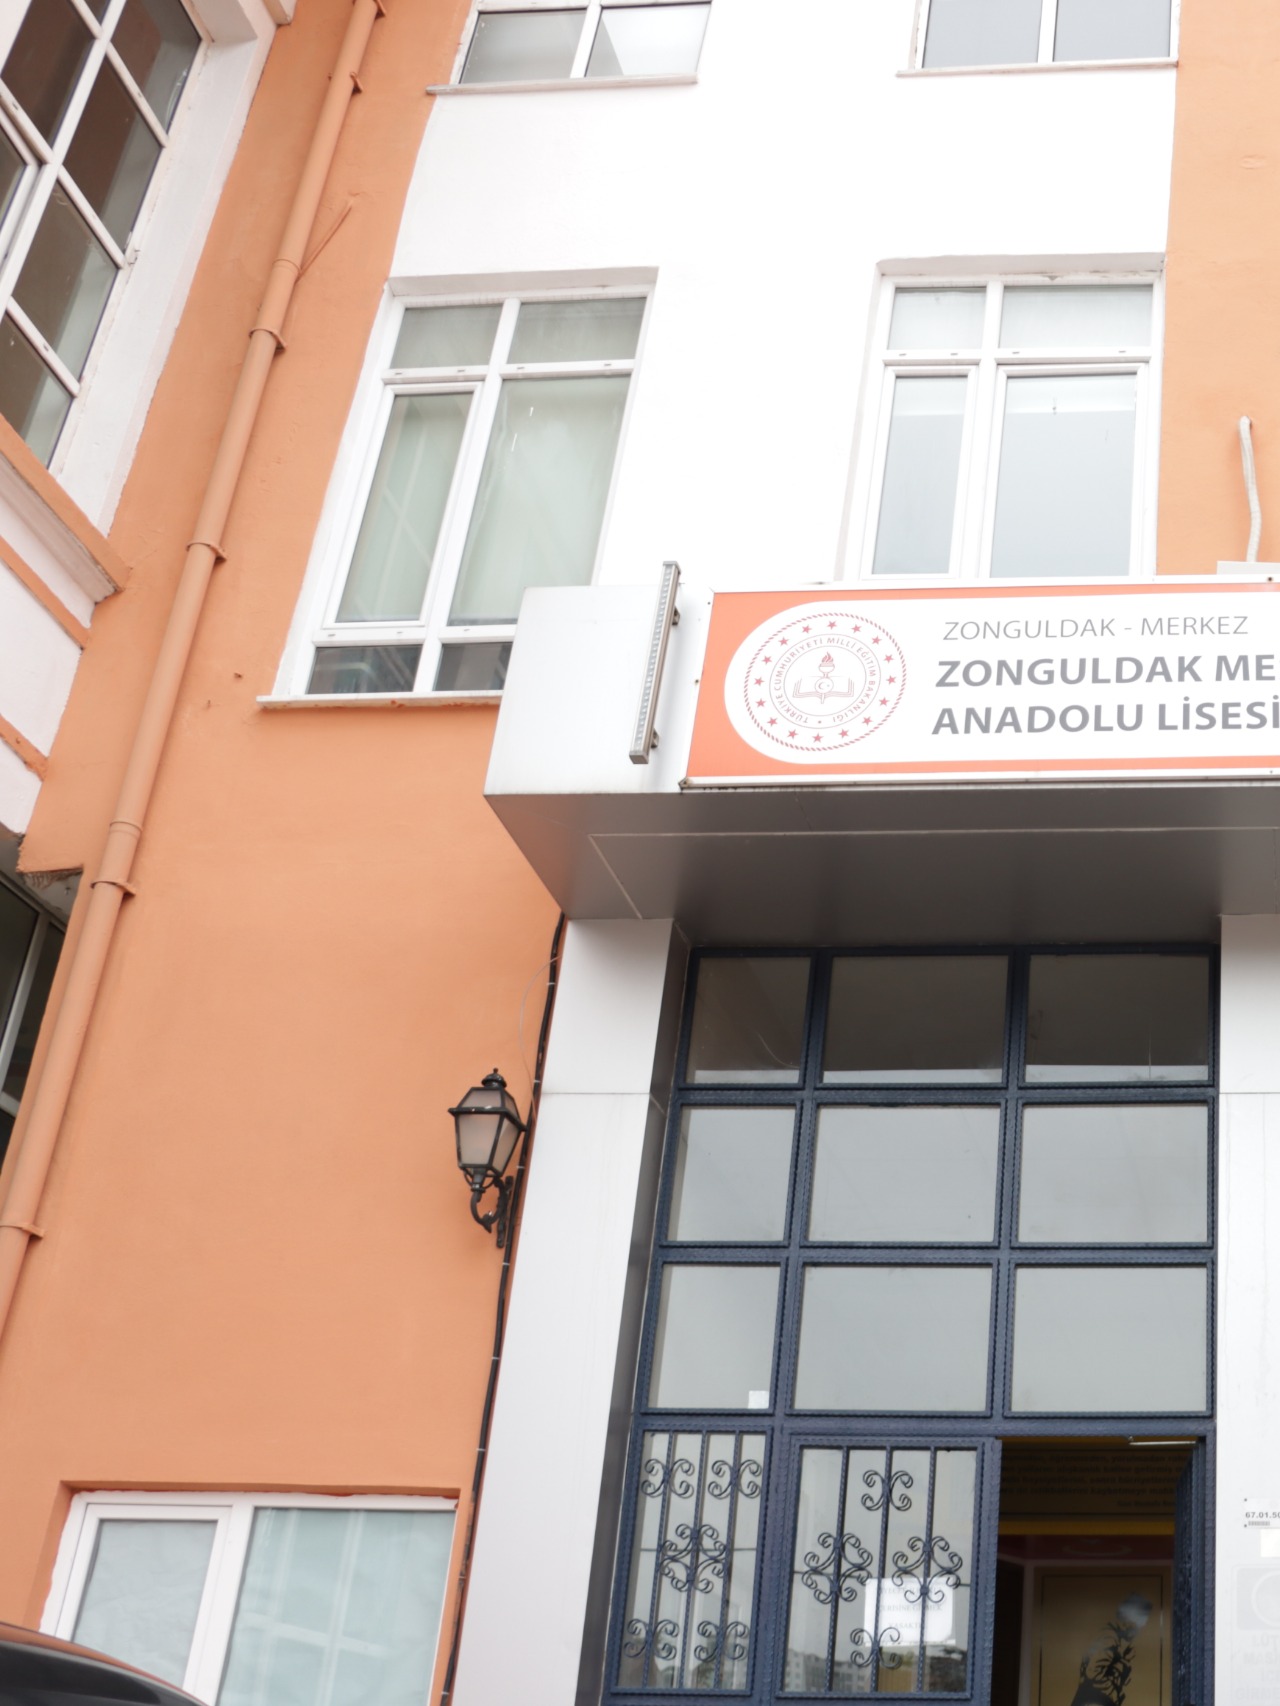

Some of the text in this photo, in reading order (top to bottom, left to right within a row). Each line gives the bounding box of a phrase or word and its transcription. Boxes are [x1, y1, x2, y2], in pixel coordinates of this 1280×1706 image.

[826, 636, 856, 649] MİLLİ
[942, 618, 1116, 641] ZONGULDAK
[1141, 615, 1249, 636] MERKEZ
[774, 637, 823, 691] CUMHURİYETİ
[856, 646, 877, 678] EĞİTİM
[935, 655, 1203, 688] ZONGULDAK
[775, 694, 809, 724] TÜRKİYE
[931, 694, 1280, 736] ANADOLU LİSESİ
